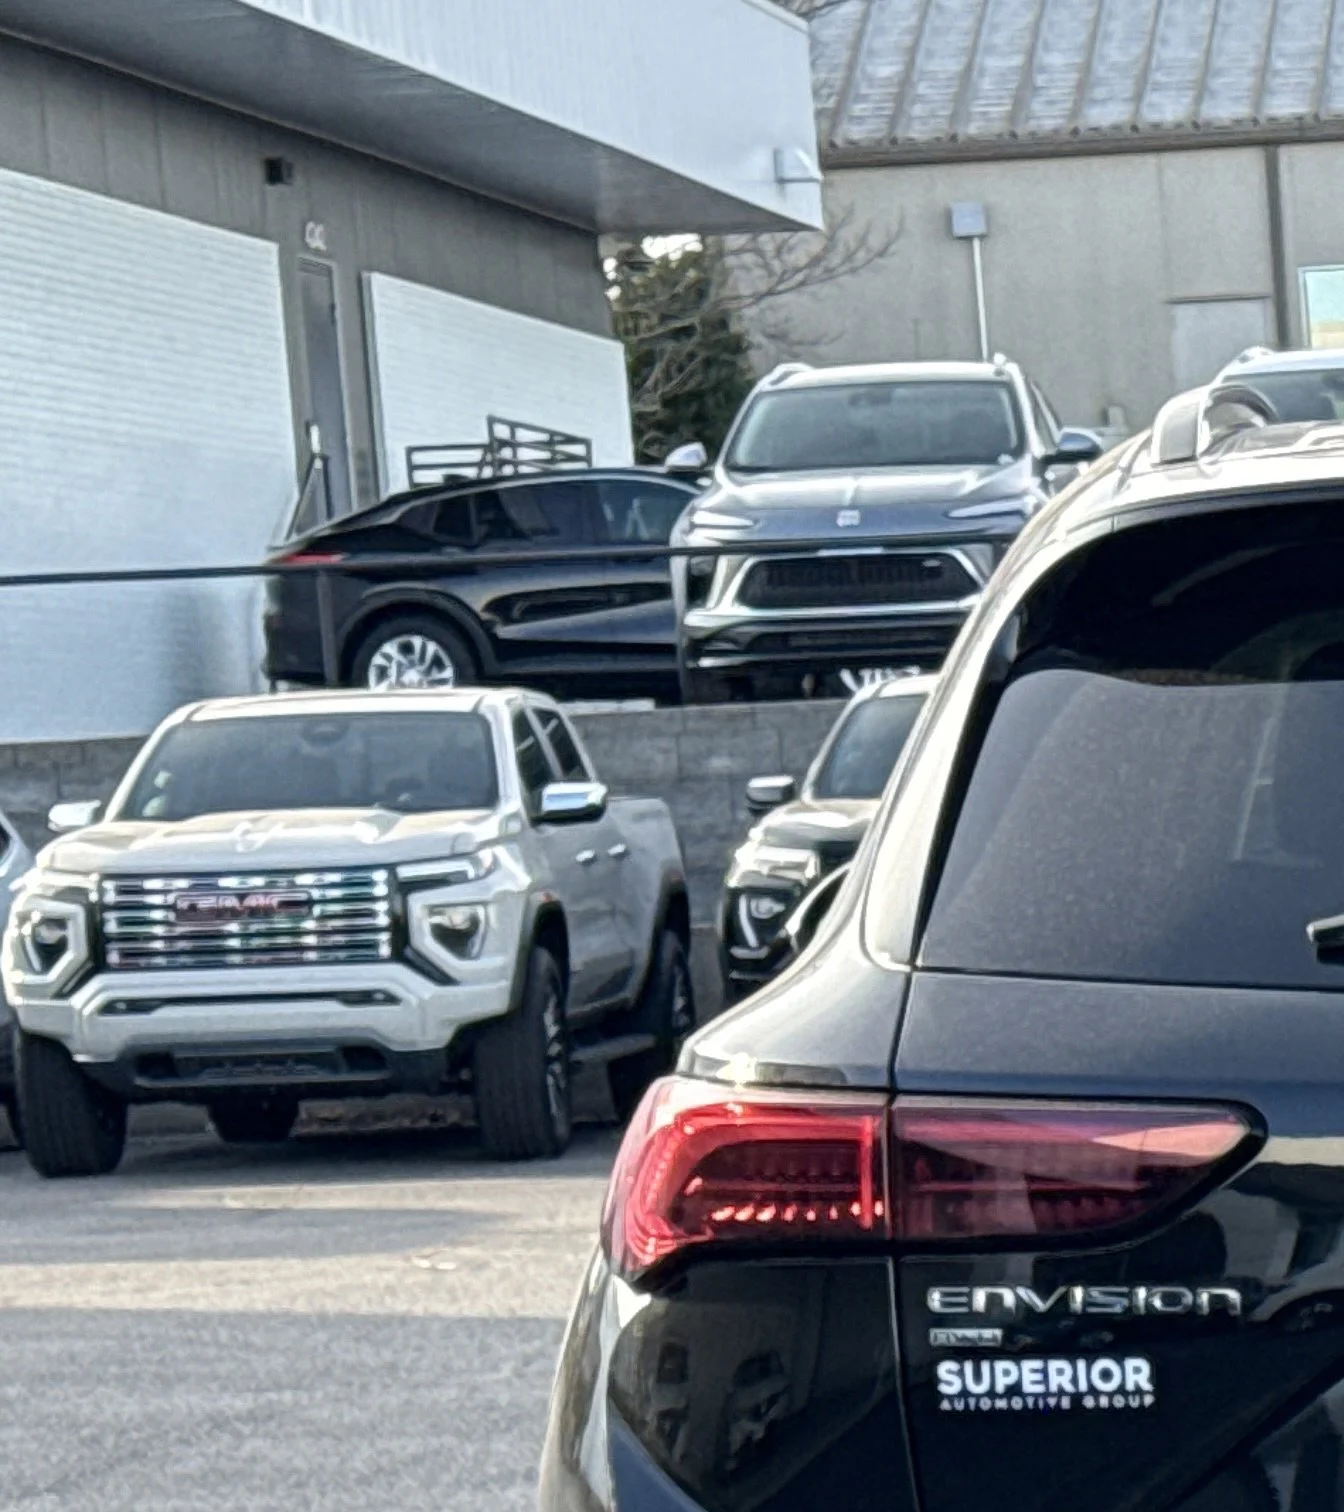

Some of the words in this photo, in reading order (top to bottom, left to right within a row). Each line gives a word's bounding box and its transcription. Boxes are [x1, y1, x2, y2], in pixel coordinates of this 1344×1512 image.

[936, 1358, 1154, 1395] SUPERIOR
[939, 1397, 1072, 1411] AUTOMOTIVE
[1081, 1395, 1155, 1410] GROUP
